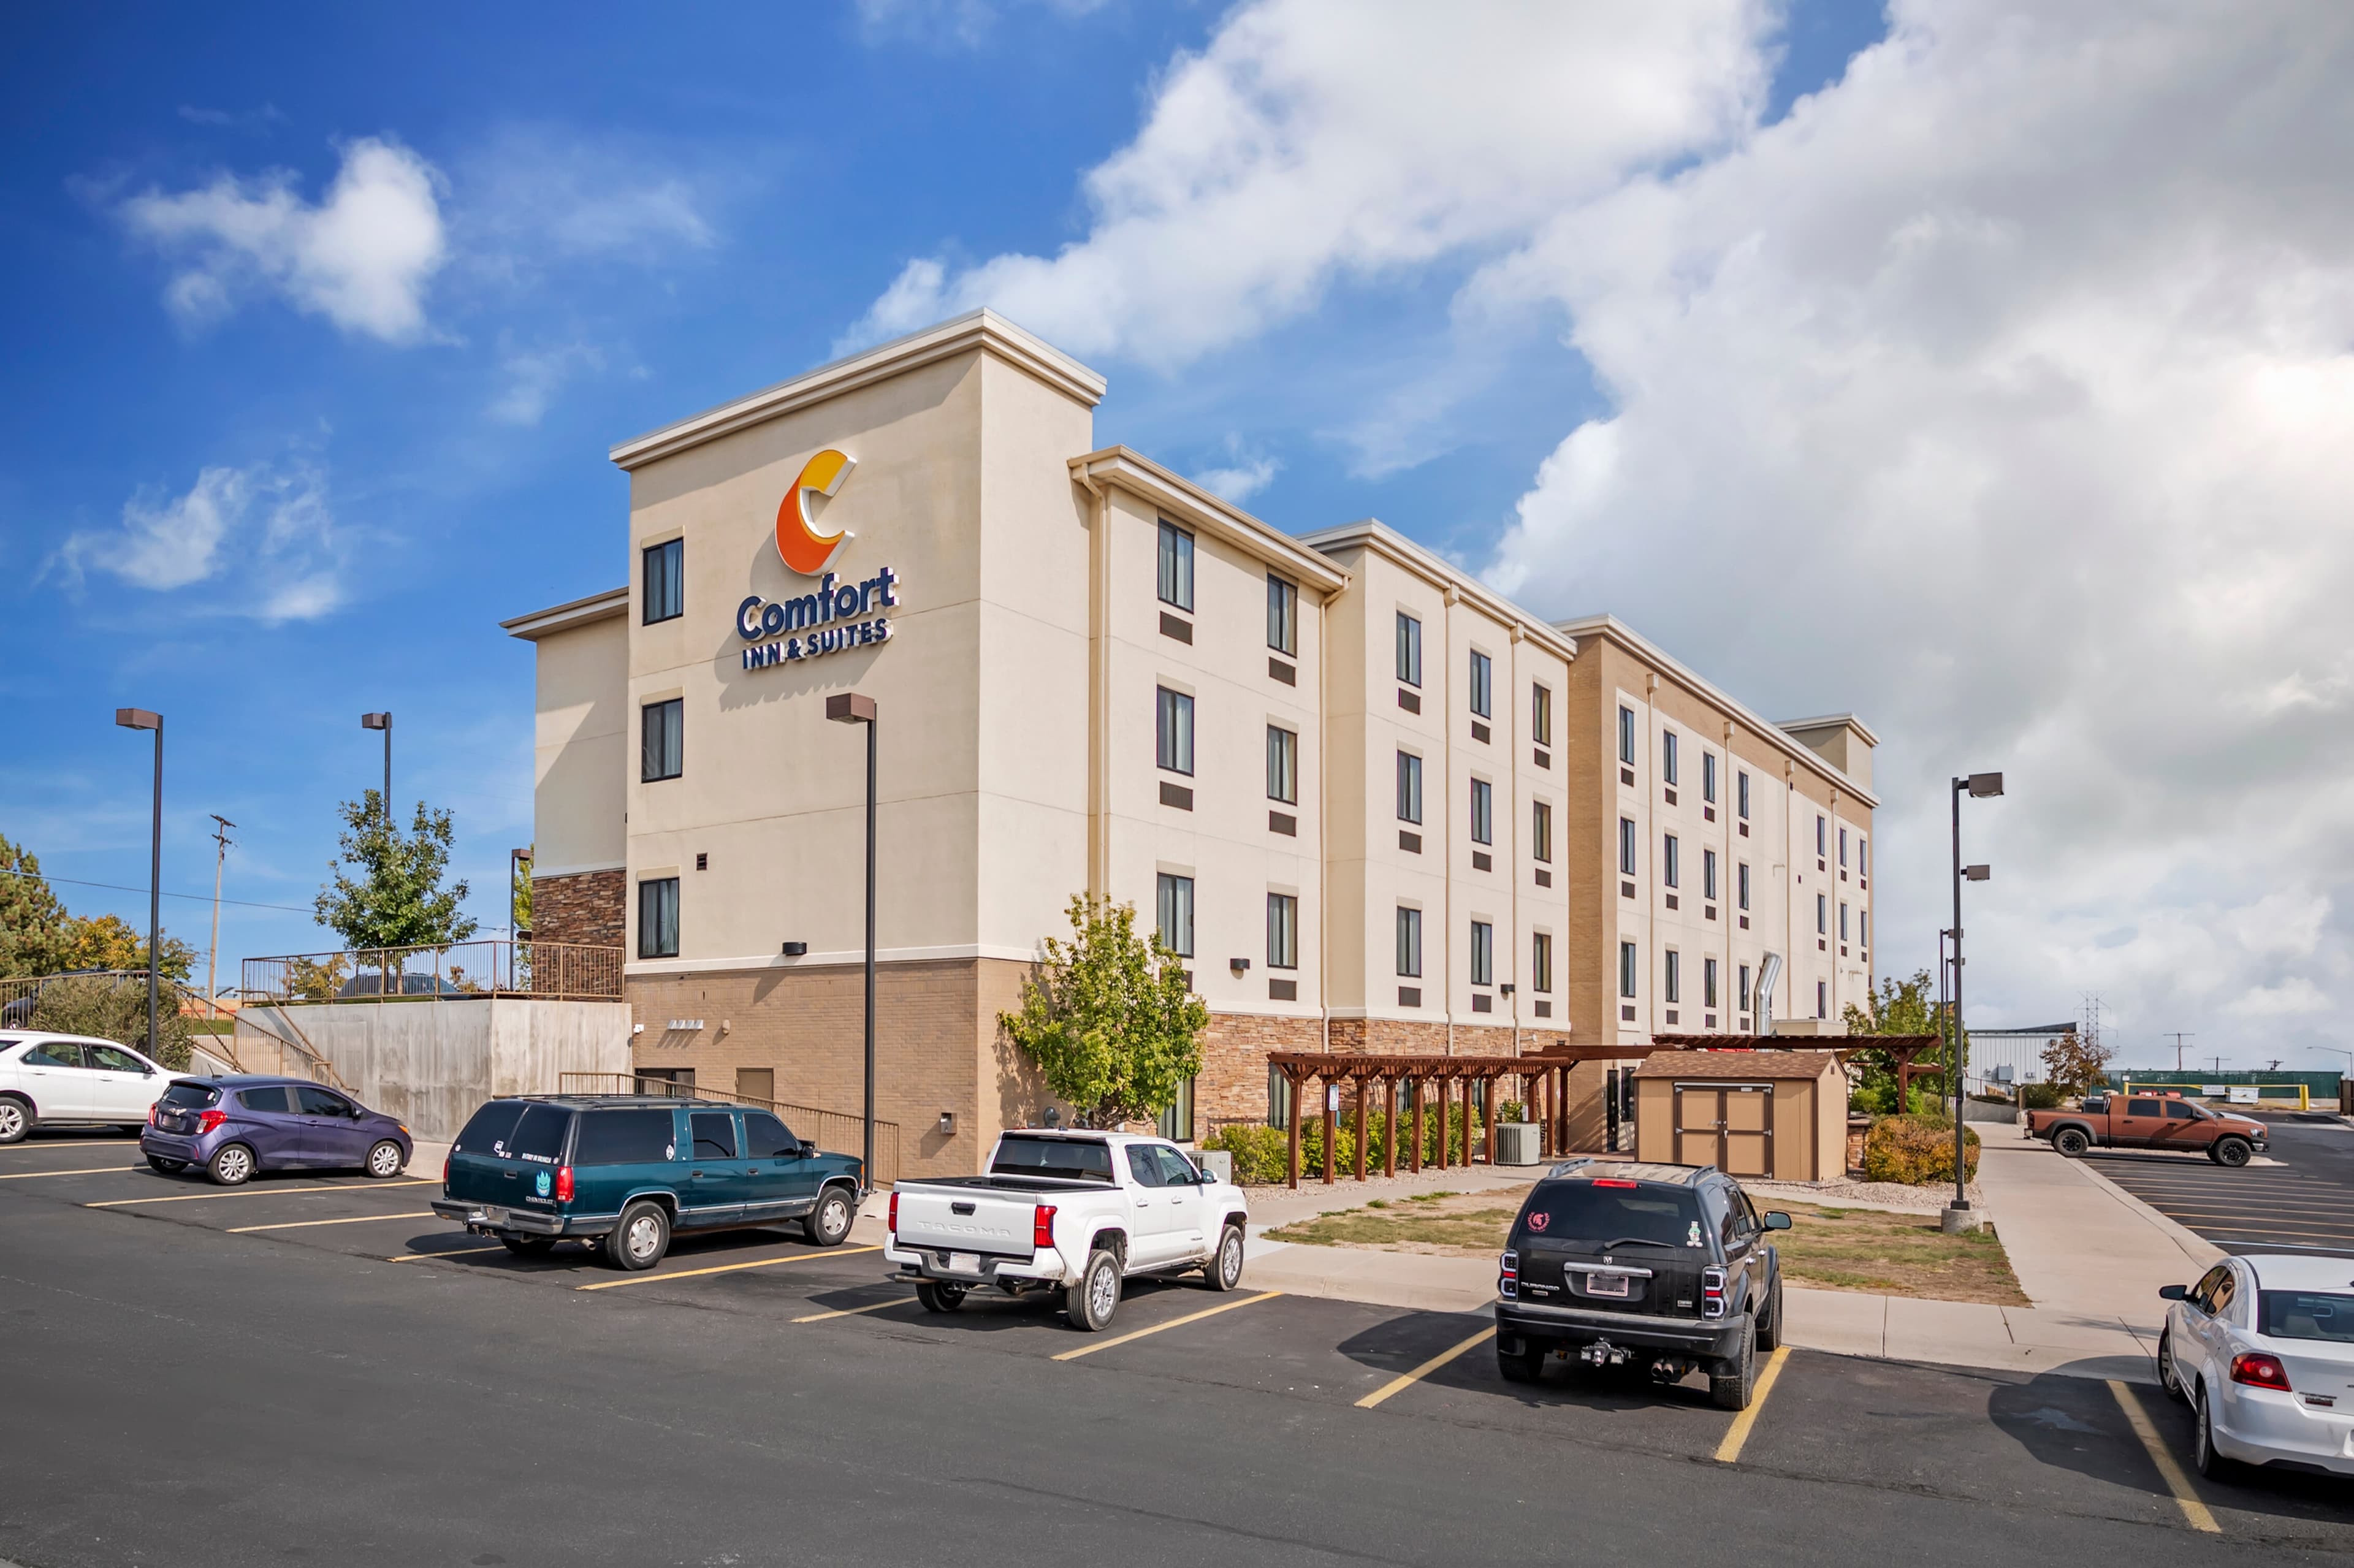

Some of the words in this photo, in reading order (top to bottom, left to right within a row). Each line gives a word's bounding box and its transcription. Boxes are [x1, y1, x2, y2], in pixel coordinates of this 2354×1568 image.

[737, 566, 899, 641] Comfort
[742, 642, 785, 669] INN
[787, 637, 806, 660] &
[807, 618, 893, 657] SUITES
[917, 1221, 1011, 1236] TACOMA
